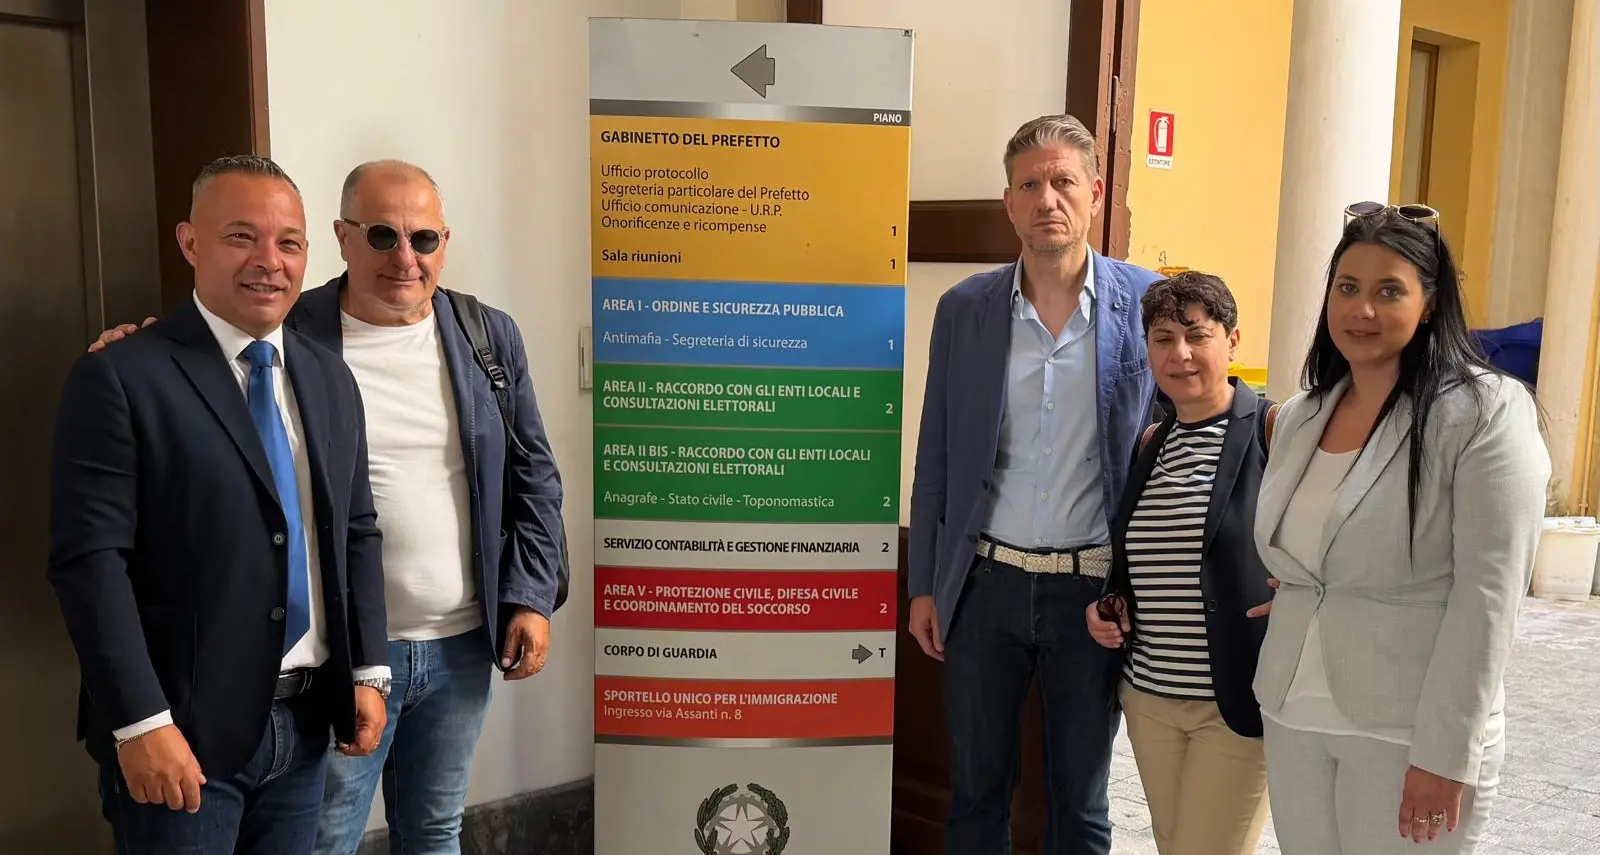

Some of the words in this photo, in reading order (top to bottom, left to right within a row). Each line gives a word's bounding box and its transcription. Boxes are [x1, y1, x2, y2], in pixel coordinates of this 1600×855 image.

[873, 113, 902, 123] PIANO
[601, 131, 679, 144] GABINETTO
[683, 133, 708, 146] DEL
[712, 135, 780, 148] PREFETTO
[601, 165, 641, 177] Ufficio
[645, 167, 708, 180] protocollo
[601, 183, 664, 197] Segreteria
[668, 186, 734, 199] particolare
[738, 186, 756, 199] del
[760, 187, 809, 201] Prefetto
[601, 200, 641, 212] Ufficio
[645, 202, 739, 215] comunicazione
[750, 204, 782, 216] U.R.P.
[601, 216, 680, 230] Onorificenze
[683, 222, 690, 230] e
[694, 220, 766, 234] ricompense
[891, 226, 897, 236] 1
[602, 250, 628, 262] Sala
[631, 251, 681, 263] riunioni
[891, 259, 896, 269] 1
[603, 299, 635, 311] AREA
[638, 301, 641, 311] I
[652, 301, 699, 313] ORDINE
[703, 303, 709, 313] E
[713, 302, 780, 315] SICUREZZA
[783, 305, 844, 317] PUBBLICA
[603, 332, 661, 345] Antimafia
[672, 333, 734, 348] Segreteria
[738, 335, 749, 347] di
[753, 336, 807, 348] sicurezza
[888, 340, 893, 350] 1
[603, 381, 635, 392] AREA
[638, 382, 646, 393] II
[656, 382, 723, 395] RACCORDO
[727, 384, 752, 396] CON
[755, 385, 774, 397] GLI
[778, 386, 805, 397] ENTI
[809, 386, 851, 398] LOCALI
[854, 387, 860, 398] E
[603, 397, 699, 410] CONSULTAZIONI
[703, 400, 775, 412] ELETTORALI
[886, 404, 893, 414] 2
[604, 444, 635, 456] AREA
[638, 445, 646, 456] II
[649, 445, 668, 457] BIS
[678, 447, 745, 459] RACCORDO
[748, 448, 773, 460] CON
[777, 448, 796, 460] GLI
[800, 449, 826, 460] ENTI
[829, 450, 870, 461] LOCALI
[604, 460, 610, 471] E
[613, 460, 709, 474] CONSULTAZIONI
[713, 464, 784, 476] ELETTORALI
[604, 491, 657, 505] Anagrafe
[668, 493, 699, 504] Stato
[703, 493, 733, 506] civile
[743, 495, 834, 509] Toponomastica
[883, 497, 890, 507] 2
[604, 538, 652, 550] SERVIZIO
[655, 539, 724, 552] CONTABILITÀ
[727, 542, 733, 551] E
[735, 541, 789, 553] GESTIONE
[791, 542, 859, 553] FINANZIARIA
[882, 543, 889, 553] 2
[604, 585, 635, 596] AREA
[637, 586, 646, 596] V
[656, 586, 730, 599] PROTEZIONE
[734, 588, 774, 600] CIVILE,
[778, 588, 818, 600] DIFESA
[822, 588, 858, 599] CIVILE
[605, 600, 610, 610] E
[613, 600, 719, 614] COORDINAMENTO
[722, 603, 744, 614] DEL
[747, 603, 810, 614] SOCCORSO
[880, 603, 887, 614] 2
[604, 644, 644, 657] CORPO
[648, 646, 659, 657] DI
[663, 647, 717, 659] GUARDIA
[879, 648, 886, 658] T
[604, 690, 671, 703] SPORTELLO
[674, 692, 711, 704] UNICO
[715, 693, 736, 704] PER
[740, 693, 837, 705] L'IMMIGRAZIONE
[604, 705, 652, 719] Ingresso
[655, 707, 672, 718] via
[676, 708, 717, 720] Assanti
[721, 711, 731, 720] n.
[734, 710, 741, 720] 8
